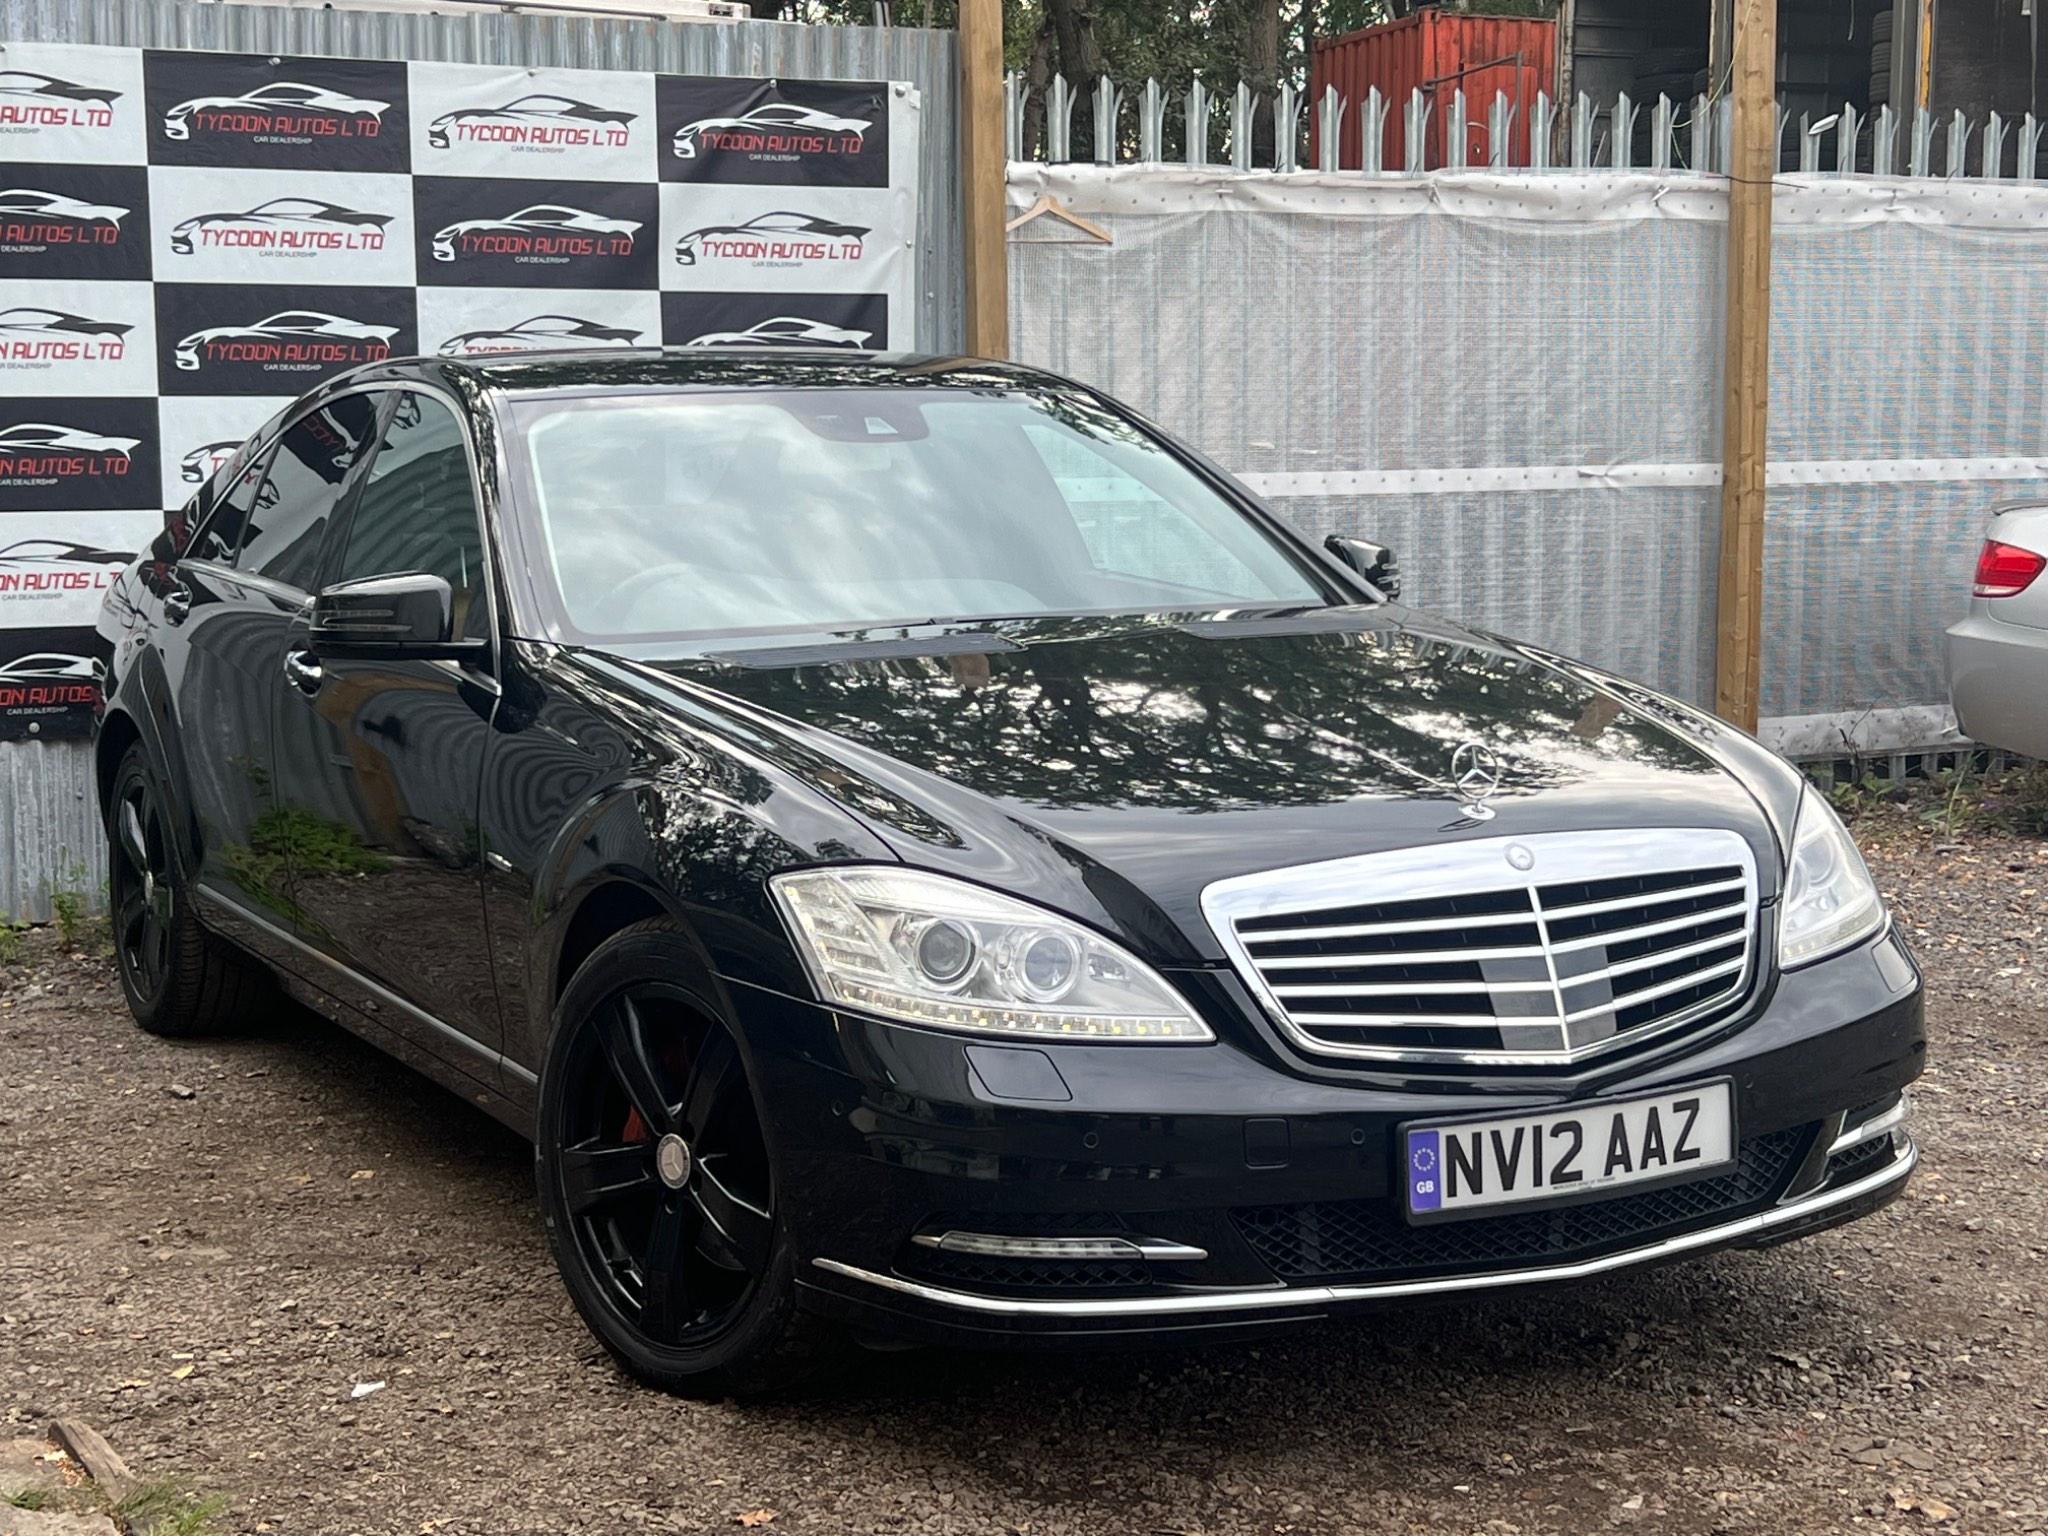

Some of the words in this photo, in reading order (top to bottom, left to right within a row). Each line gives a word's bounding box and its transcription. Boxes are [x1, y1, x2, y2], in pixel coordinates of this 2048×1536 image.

[0, 106, 68, 125] AUTOS
[72, 109, 112, 127] LTD
[195, 113, 271, 133] TYCOON
[275, 116, 337, 135] AUTOS
[341, 119, 379, 137] LTD
[253, 135, 268, 143] CAR
[269, 136, 313, 144] DEALERSHIP
[457, 124, 527, 142] TYCOON
[530, 127, 590, 145] AUTOS
[593, 129, 628, 147] LTD
[701, 133, 765, 151] TYCOON
[767, 135, 825, 153] AUTOS
[827, 137, 862, 154] LTD
[749, 153, 762, 161] CAR
[6, 224, 74, 243] AUTOS
[77, 226, 118, 244] LTD
[201, 229, 277, 247] TYCOON
[280, 231, 343, 249] AUTOS
[346, 233, 384, 250] LTD
[462, 235, 531, 254] TYCOON
[535, 237, 594, 255] AUTOS
[596, 239, 632, 256] LTD
[702, 241, 767, 258] TYCOON
[770, 243, 826, 259] AUTOS
[829, 244, 862, 260] LTD
[12, 342, 80, 359] AUTOS
[83, 343, 124, 360] LTD
[206, 343, 282, 361] TYCOON
[284, 344, 347, 361] AUTOS
[350, 344, 389, 362] LTD
[264, 363, 278, 371] CAR
[18, 457, 85, 475] AUTOS
[88, 457, 129, 475] LTD
[12, 478, 58, 486] DEALERSHIP
[23, 572, 91, 590] AUTOS
[18, 593, 63, 601] DEALERSHIP
[29, 685, 93, 704] AUTOS
[7, 708, 22, 716] CAR
[23, 706, 68, 714] DEALERSHIP
[1445, 1120, 1583, 1198] NV12
[1604, 1097, 1700, 1176] AAZ
[1416, 1180, 1434, 1194] GB
